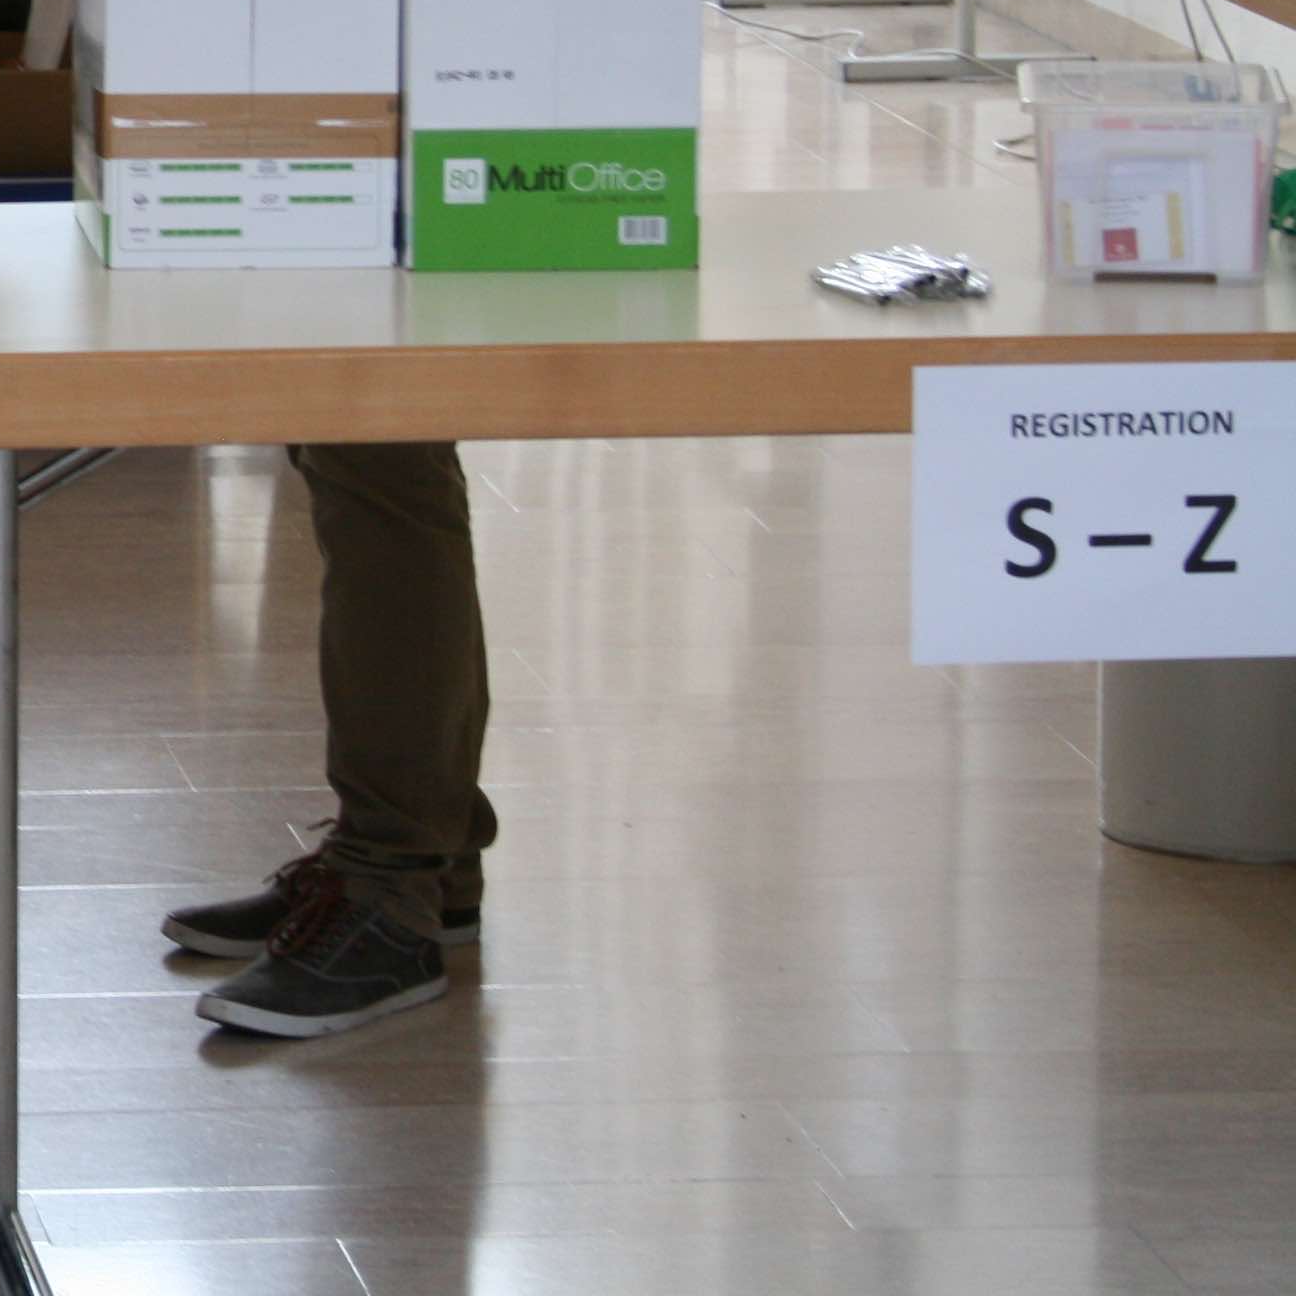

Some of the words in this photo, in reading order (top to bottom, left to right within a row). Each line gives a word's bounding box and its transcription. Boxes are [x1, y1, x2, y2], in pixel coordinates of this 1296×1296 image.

[488, 162, 666, 192] MultiOffice
[1011, 410, 1234, 438] REGISTRATION
[1005, 496, 1057, 579] S
[1183, 494, 1238, 574] Z
